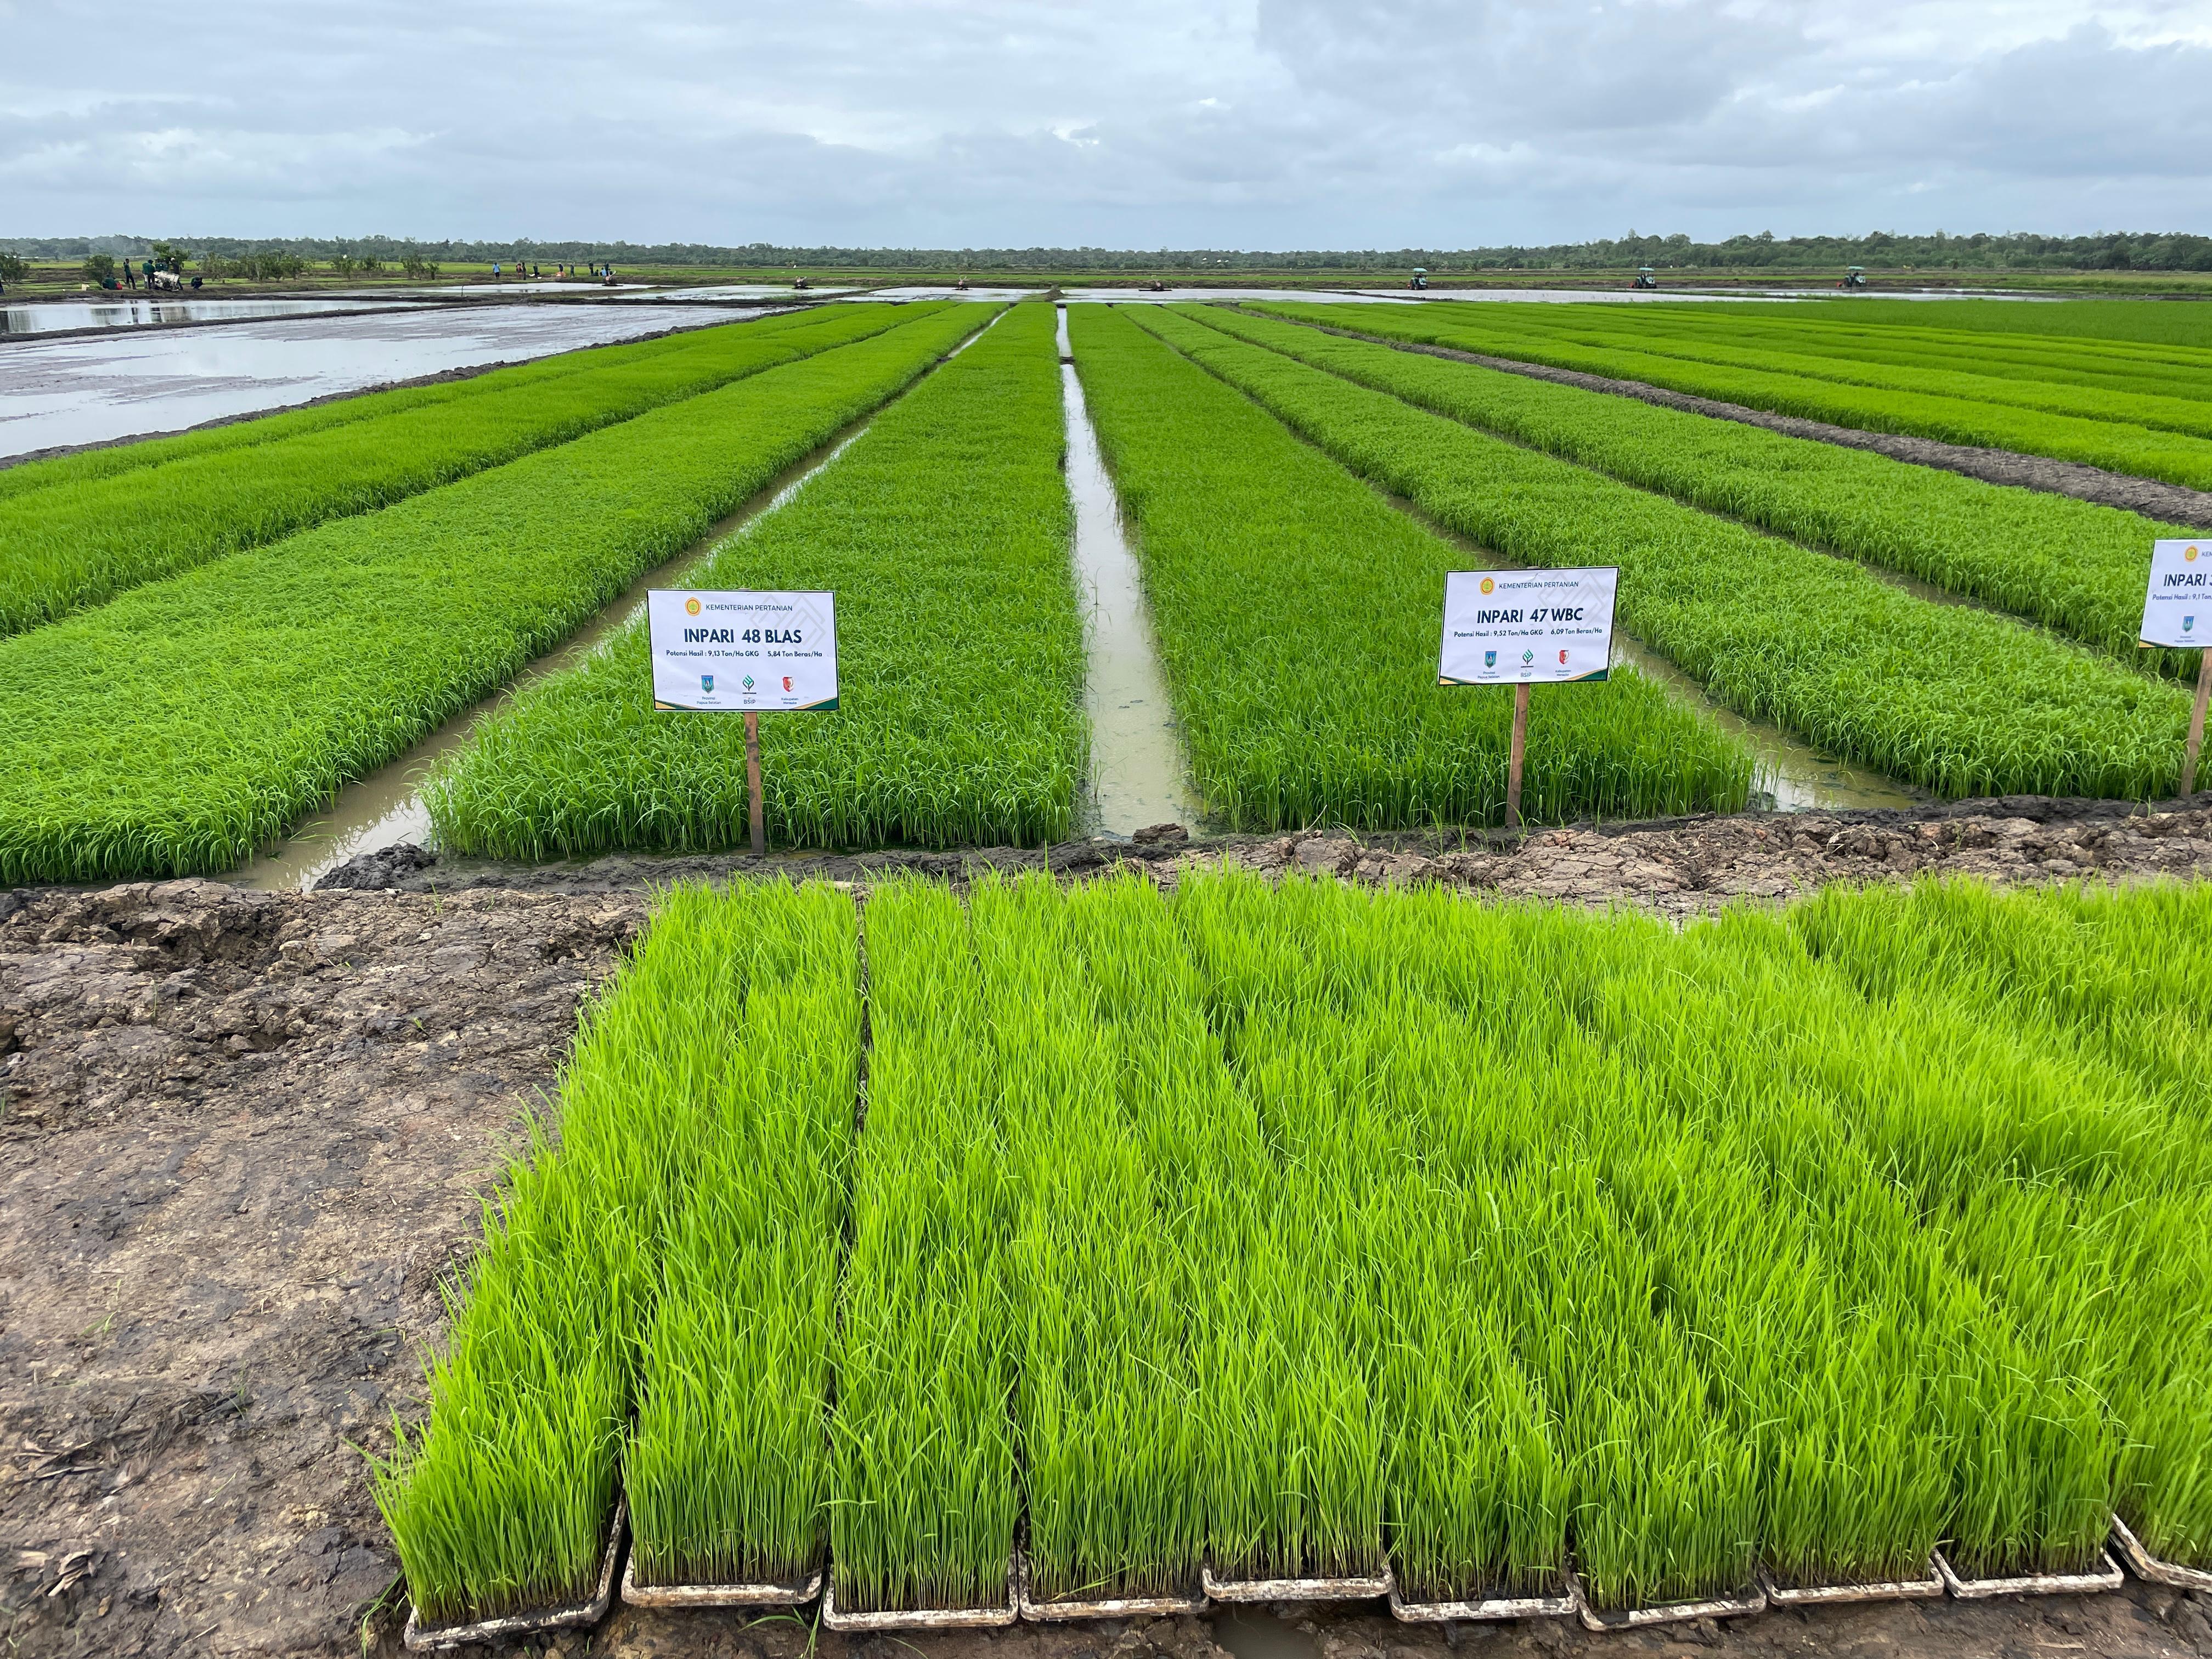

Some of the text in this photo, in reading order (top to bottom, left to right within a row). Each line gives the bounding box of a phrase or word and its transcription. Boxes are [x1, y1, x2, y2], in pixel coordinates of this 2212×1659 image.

[2163, 573, 2207, 586] INPARI
[1477, 607, 1584, 624] INPARI 47 WBC
[684, 628, 802, 644] INPARI 48 BLAS
